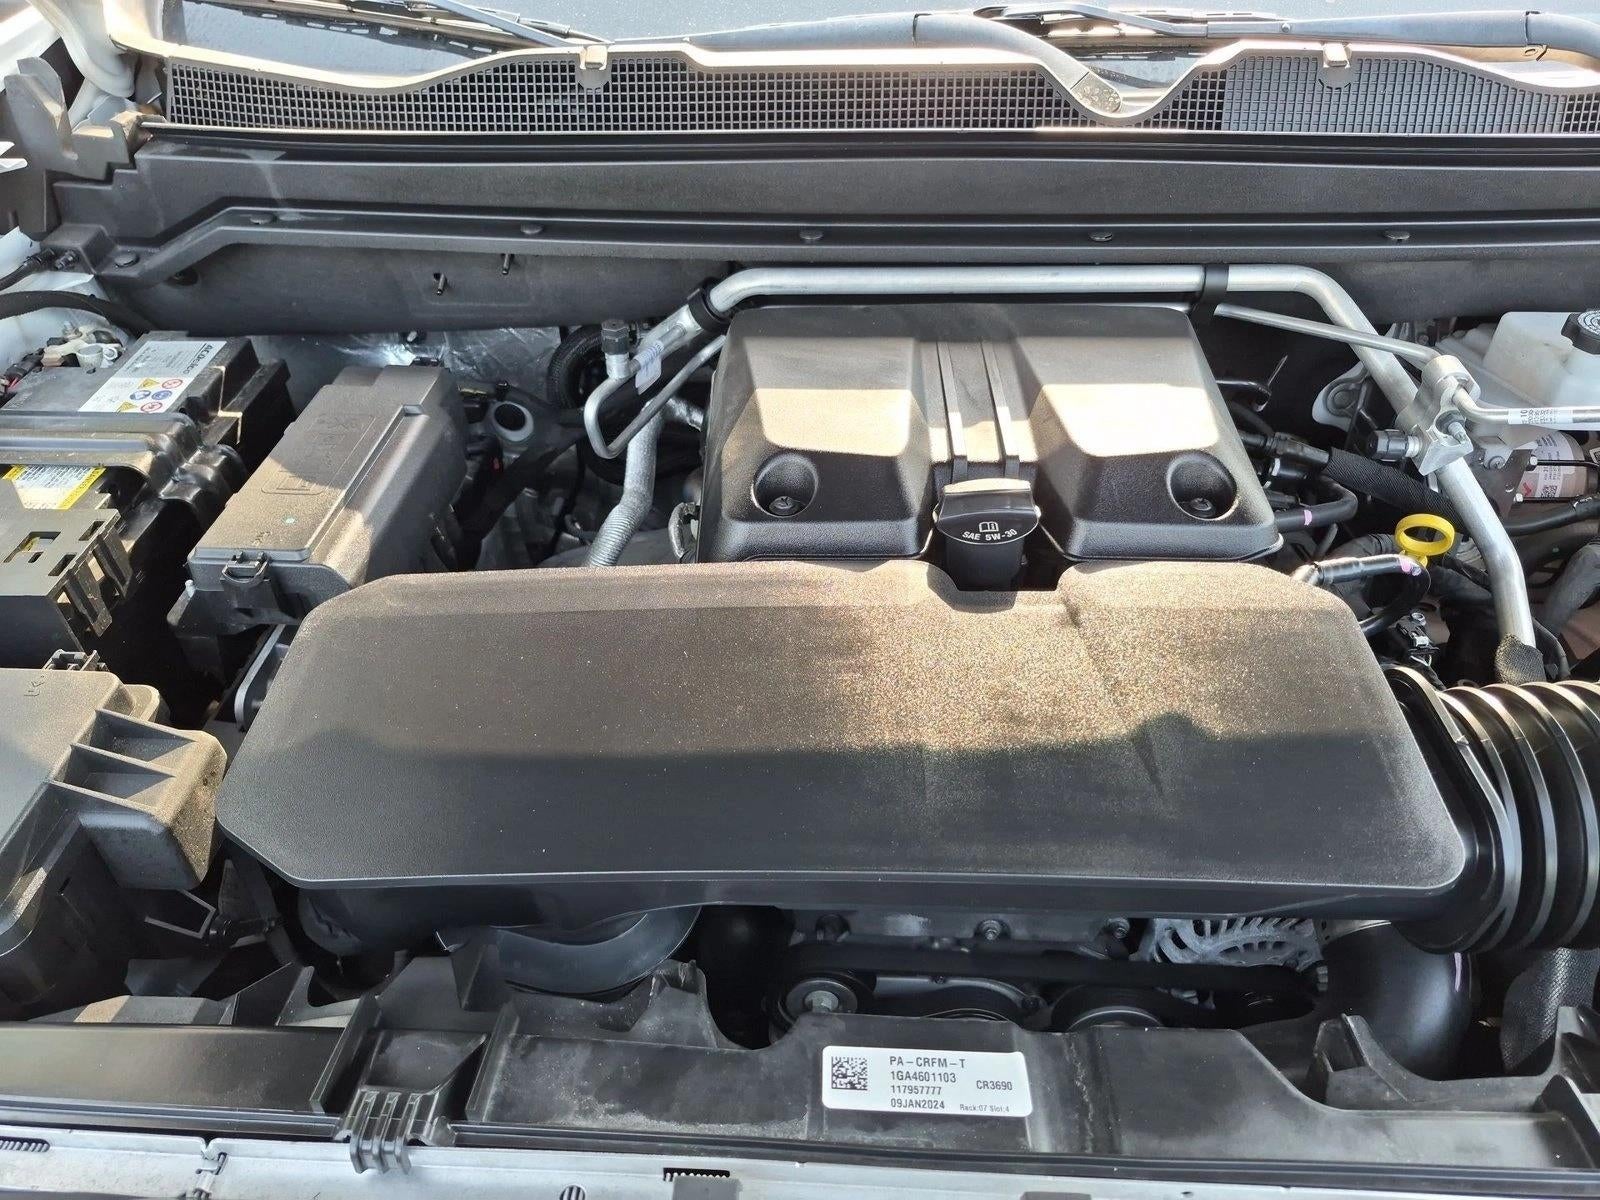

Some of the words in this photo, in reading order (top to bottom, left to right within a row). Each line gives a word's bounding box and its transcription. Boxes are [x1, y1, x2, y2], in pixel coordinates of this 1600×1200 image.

[962, 531, 981, 540] SAE
[985, 528, 1018, 540] 5W-30
[890, 1070, 957, 1083] 1GA4601103
[890, 1085, 942, 1095] 117957777
[976, 1079, 1013, 1091] CR3690
[890, 1098, 945, 1109] 09JAN2024
